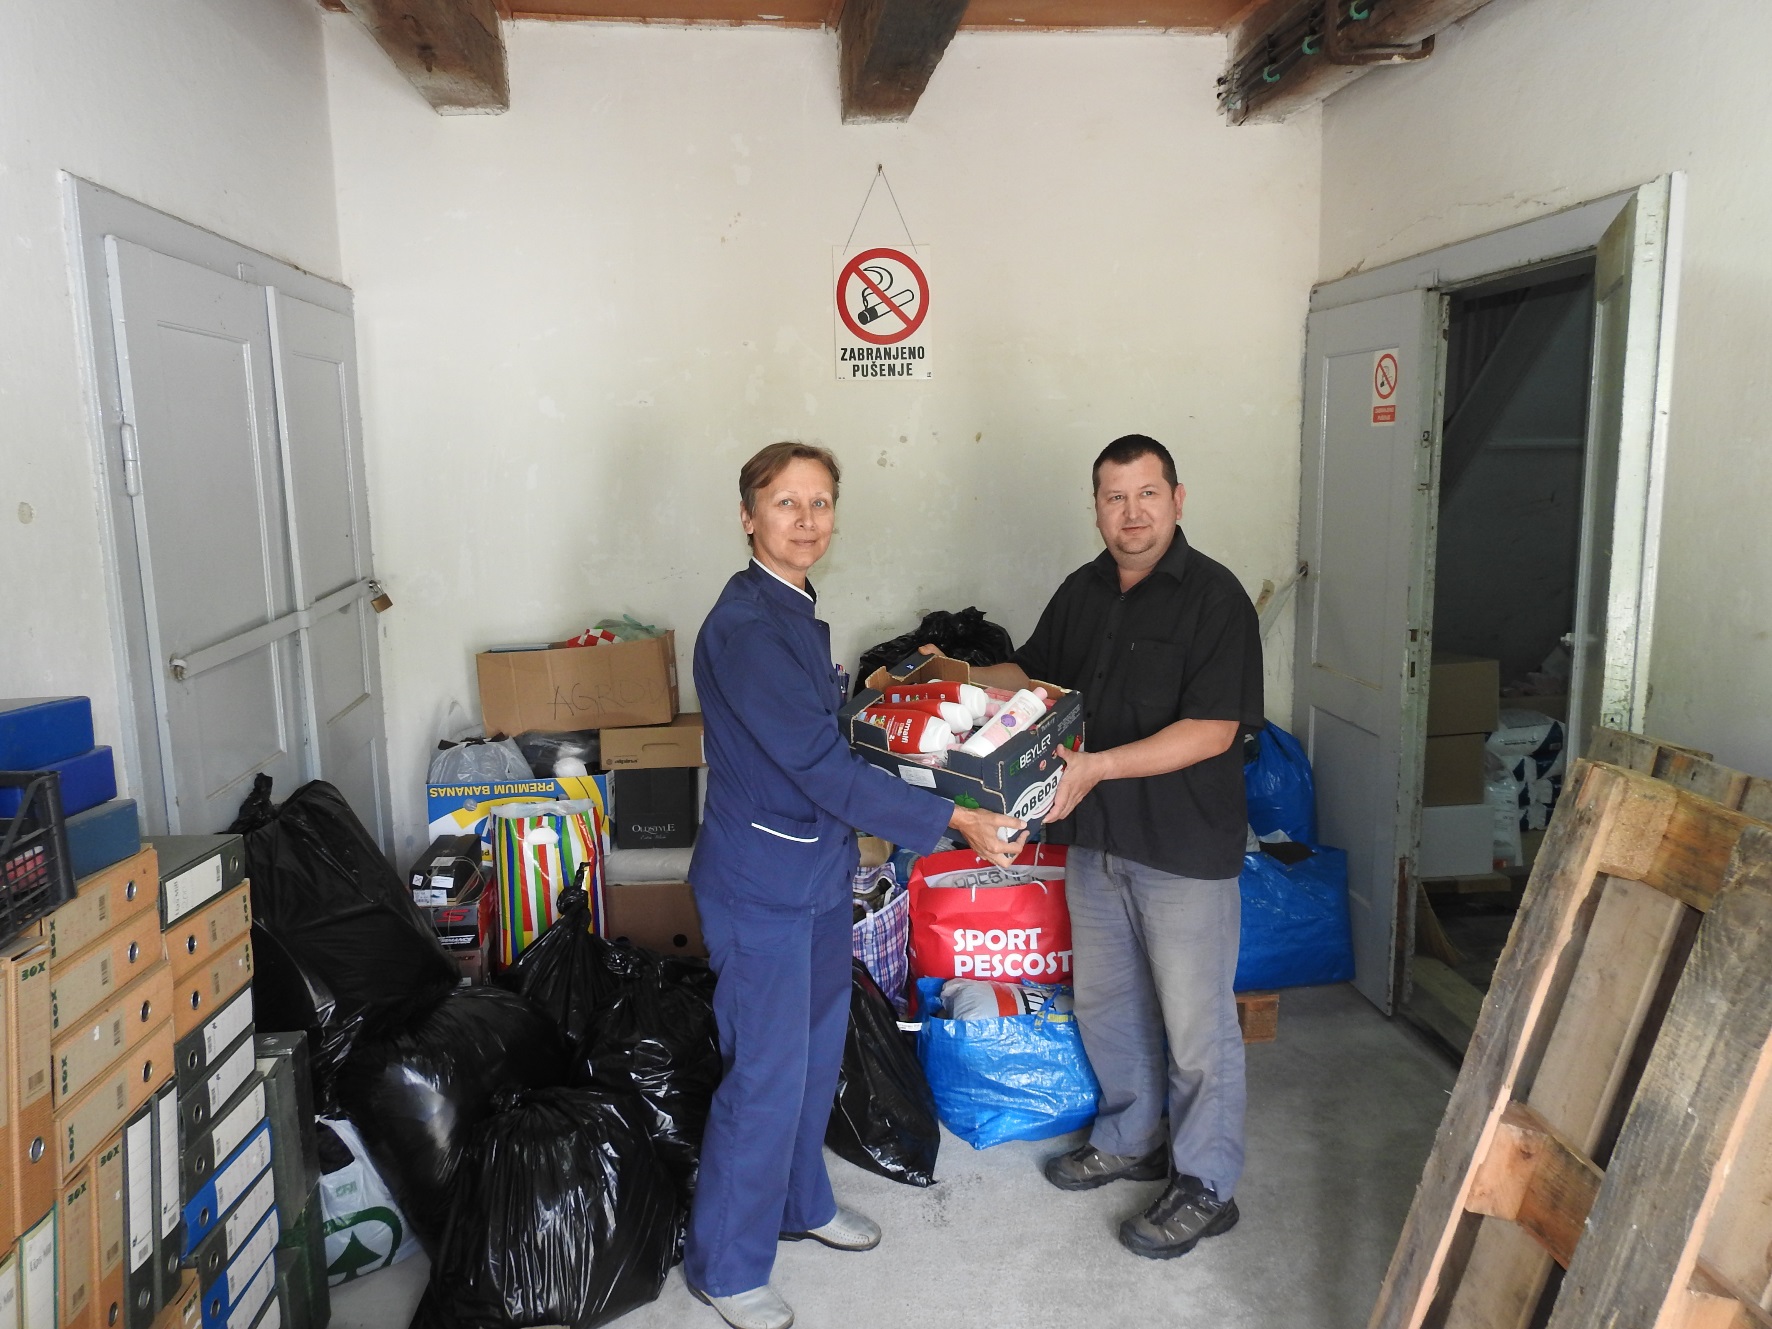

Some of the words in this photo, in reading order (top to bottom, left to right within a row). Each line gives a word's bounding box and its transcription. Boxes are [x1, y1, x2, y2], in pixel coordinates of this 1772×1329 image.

[840, 346, 925, 361] ZABRANJENO
[852, 361, 913, 378] PUŠENJE
[429, 784, 490, 798] BANANAS
[494, 781, 555, 795] PREMIUM
[953, 928, 1041, 952] SPORT
[21, 960, 46, 982] BOX
[954, 950, 1073, 977] PESCOST
[100, 1143, 120, 1168] BOX
[67, 1180, 87, 1206] BOX
